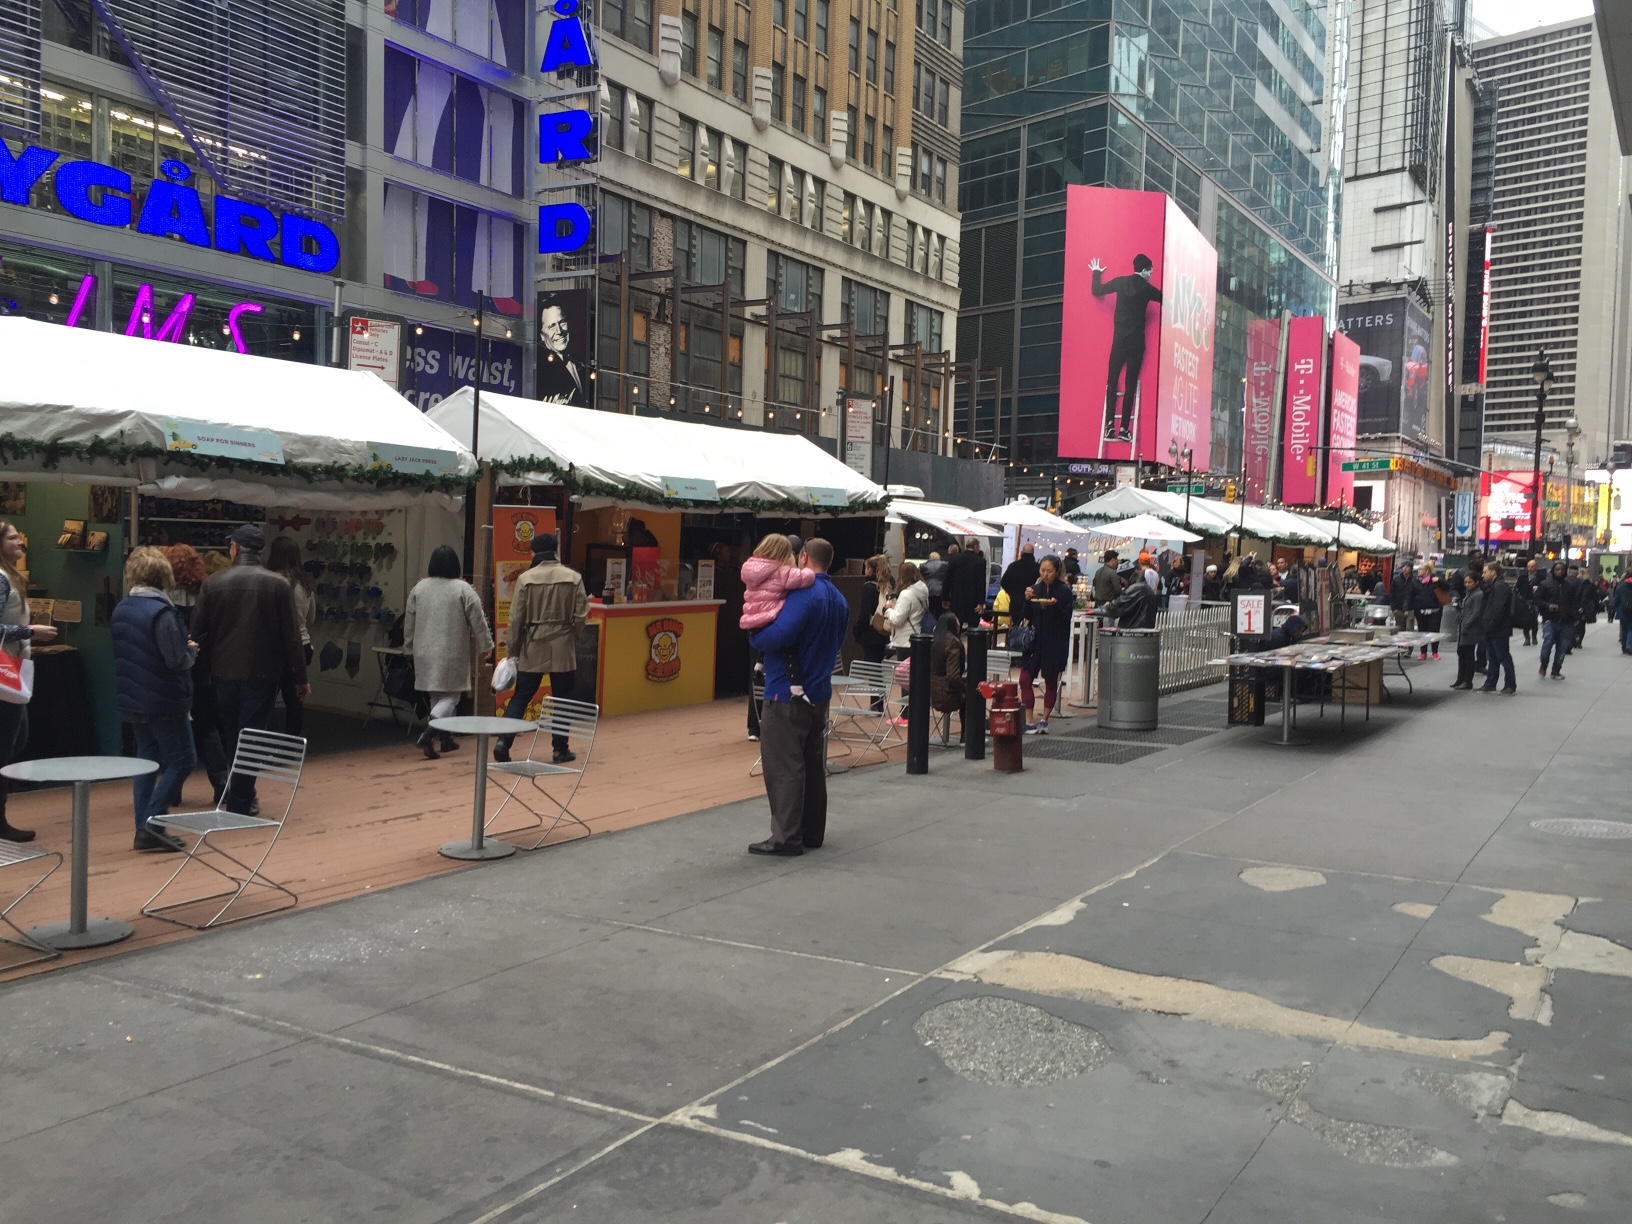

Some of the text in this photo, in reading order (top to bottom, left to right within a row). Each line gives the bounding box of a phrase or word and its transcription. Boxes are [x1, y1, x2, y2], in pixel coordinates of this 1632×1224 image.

[353, 346, 374, 354] Diplomat
[352, 353, 371, 361] License
[1173, 342, 1200, 381] FASTEST
[1184, 379, 1198, 418] LTE
[197, 435, 214, 443] SOAP
[230, 440, 256, 448] SINNERS
[1362, 462, 1369, 470] 41
[1240, 599, 1262, 609] SALE
[1244, 609, 1255, 633] 1
